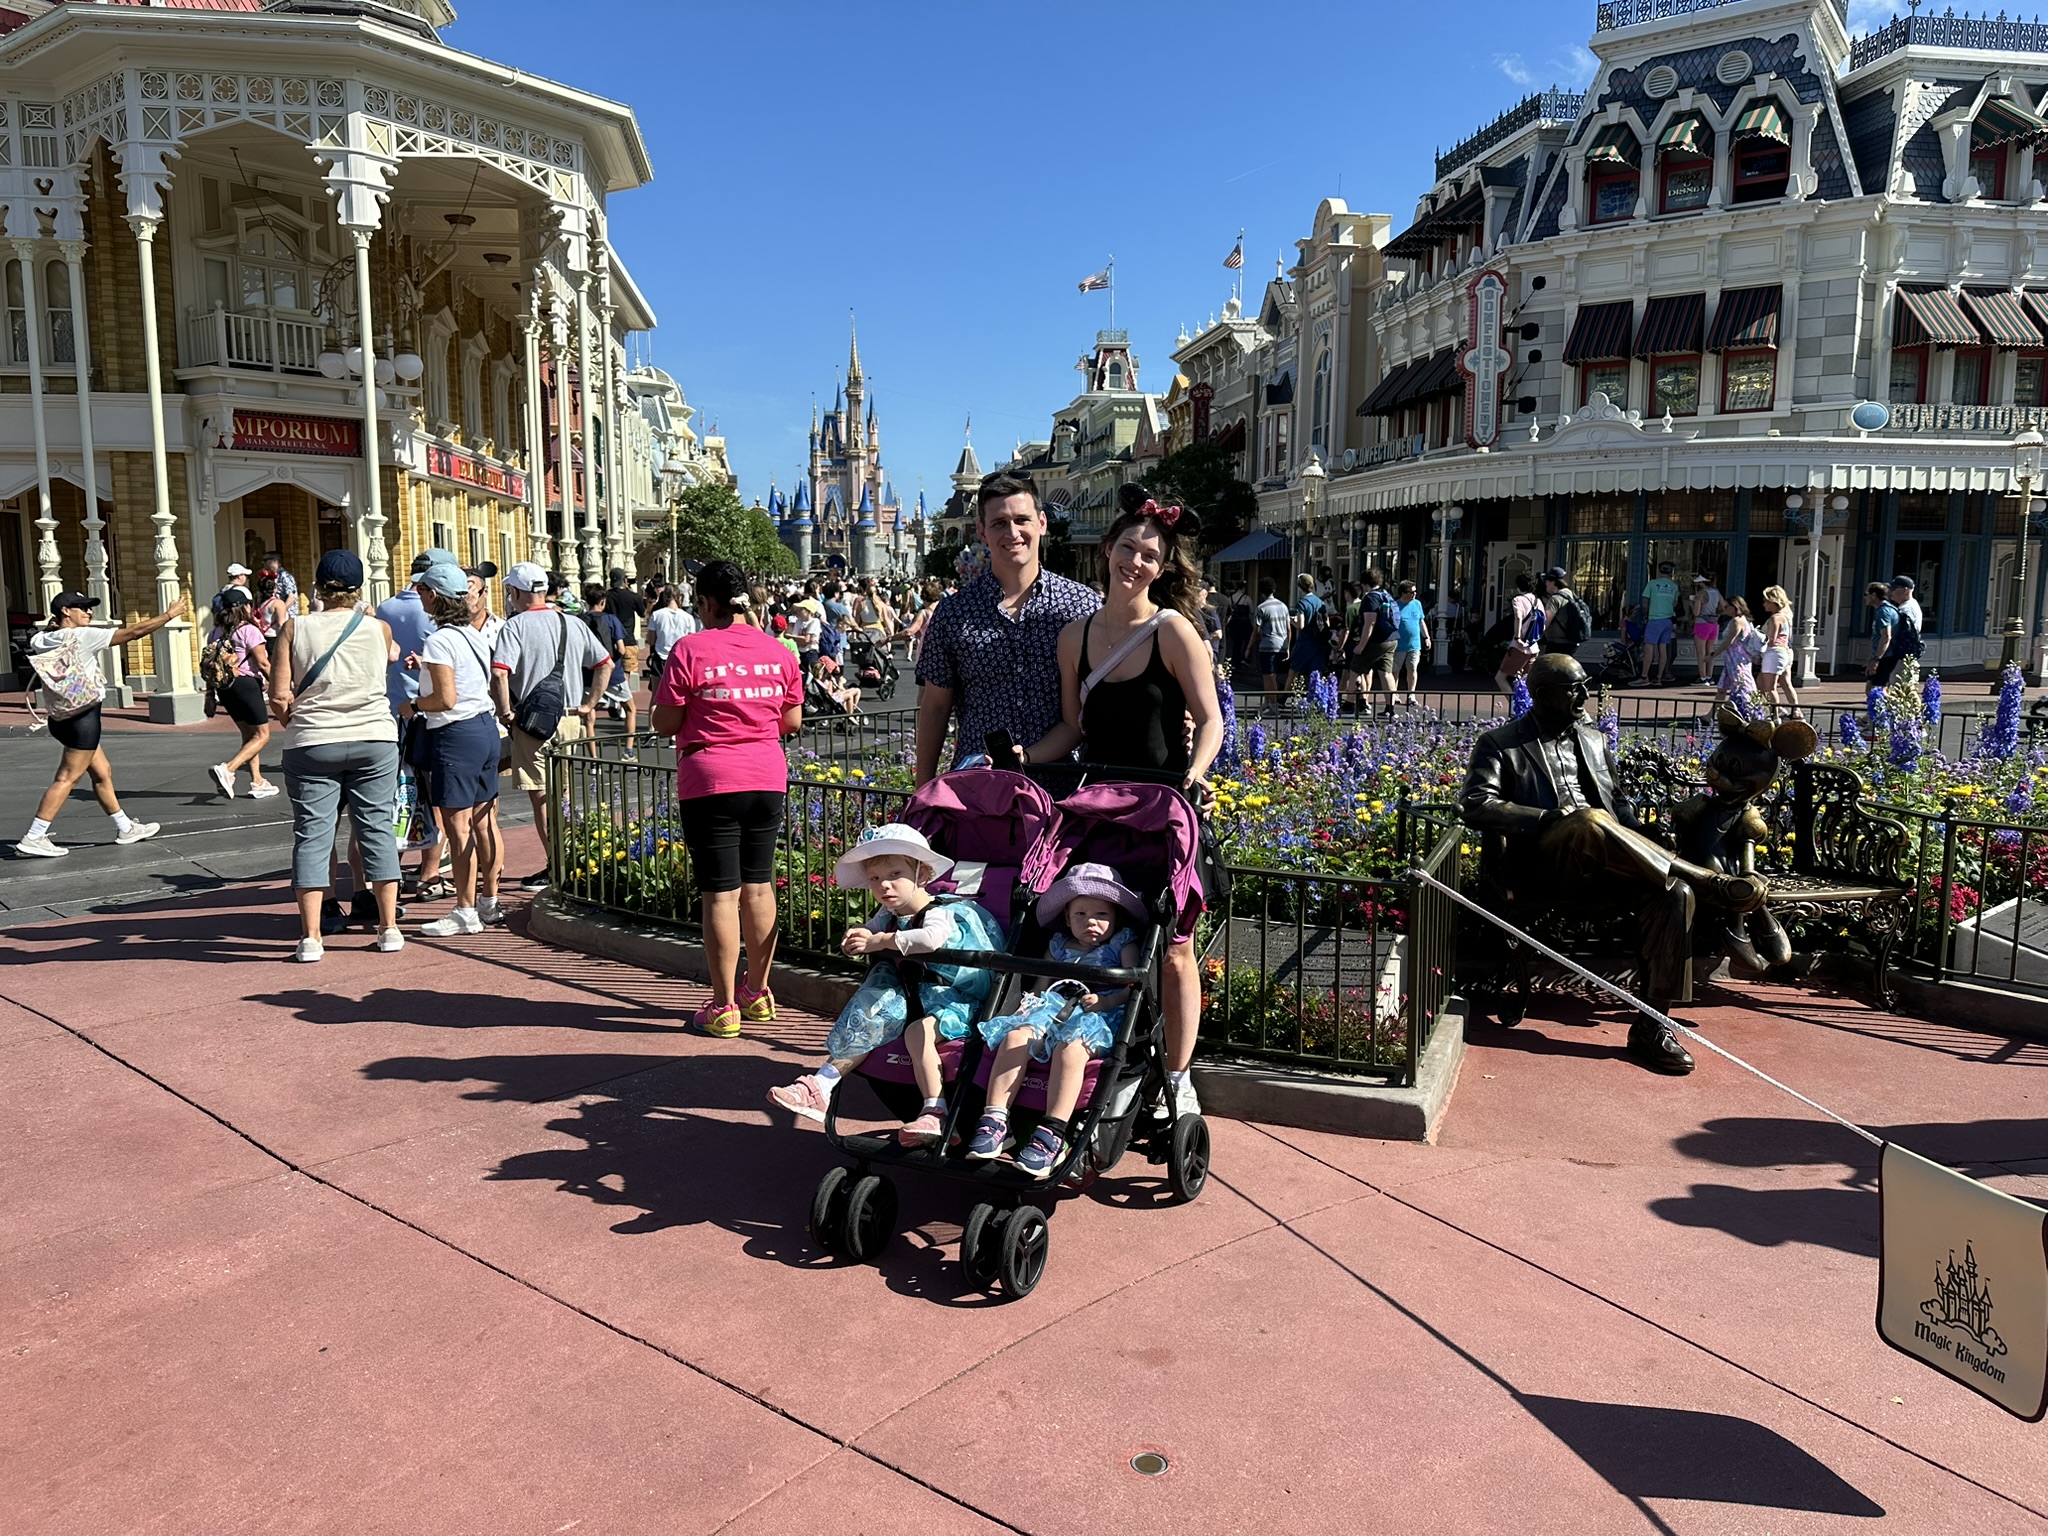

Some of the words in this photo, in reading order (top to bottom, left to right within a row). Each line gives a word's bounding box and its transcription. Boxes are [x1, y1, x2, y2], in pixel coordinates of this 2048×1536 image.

[1668, 185, 1707, 197] DISNEY
[1483, 289, 1496, 437] CONFECTIONERY
[219, 416, 350, 445] MPORIUM
[244, 437, 268, 446] MAIN
[753, 663, 782, 676] MY
[886, 1053, 913, 1066] ZO
[1914, 1320, 1952, 1352] Magic
[1955, 1342, 2006, 1384] Kingdom
